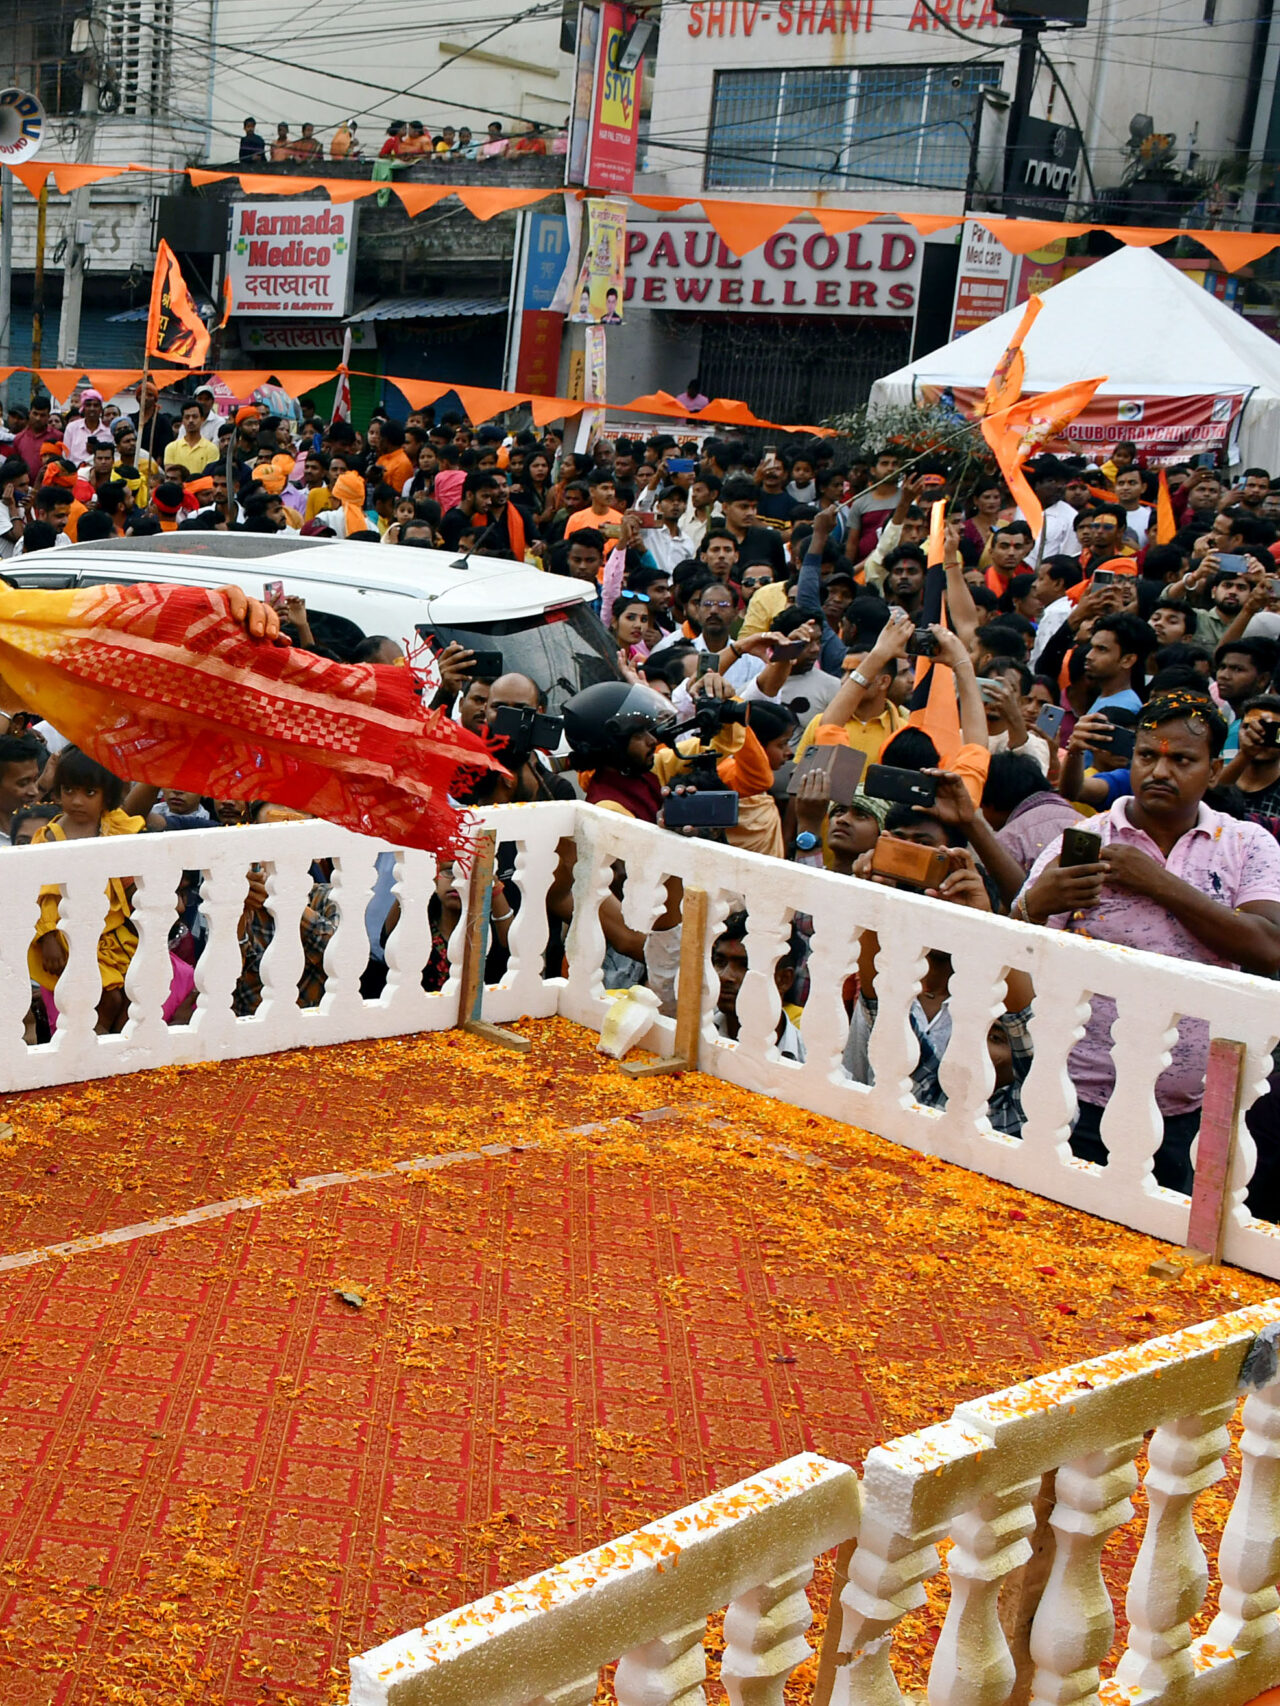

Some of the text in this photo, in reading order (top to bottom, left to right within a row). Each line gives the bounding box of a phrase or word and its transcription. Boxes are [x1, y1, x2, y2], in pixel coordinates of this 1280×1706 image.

[687, 0, 873, 37] SHIV-SHANI
[1024, 159, 1079, 194] nirvana
[240, 208, 344, 236] Narmada
[248, 241, 331, 267] Medico
[623, 231, 917, 272] PAUL GOLD
[966, 246, 1002, 266] Med care
[245, 275, 330, 296] दवाखाना
[623, 276, 916, 310] JEWELLERS
[263, 326, 344, 348] दवाखाना
[1068, 424, 1105, 441] CLUB
[1107, 425, 1127, 442] OF
[1128, 424, 1180, 442] RANCHI
[1183, 422, 1228, 441] YOUTH
